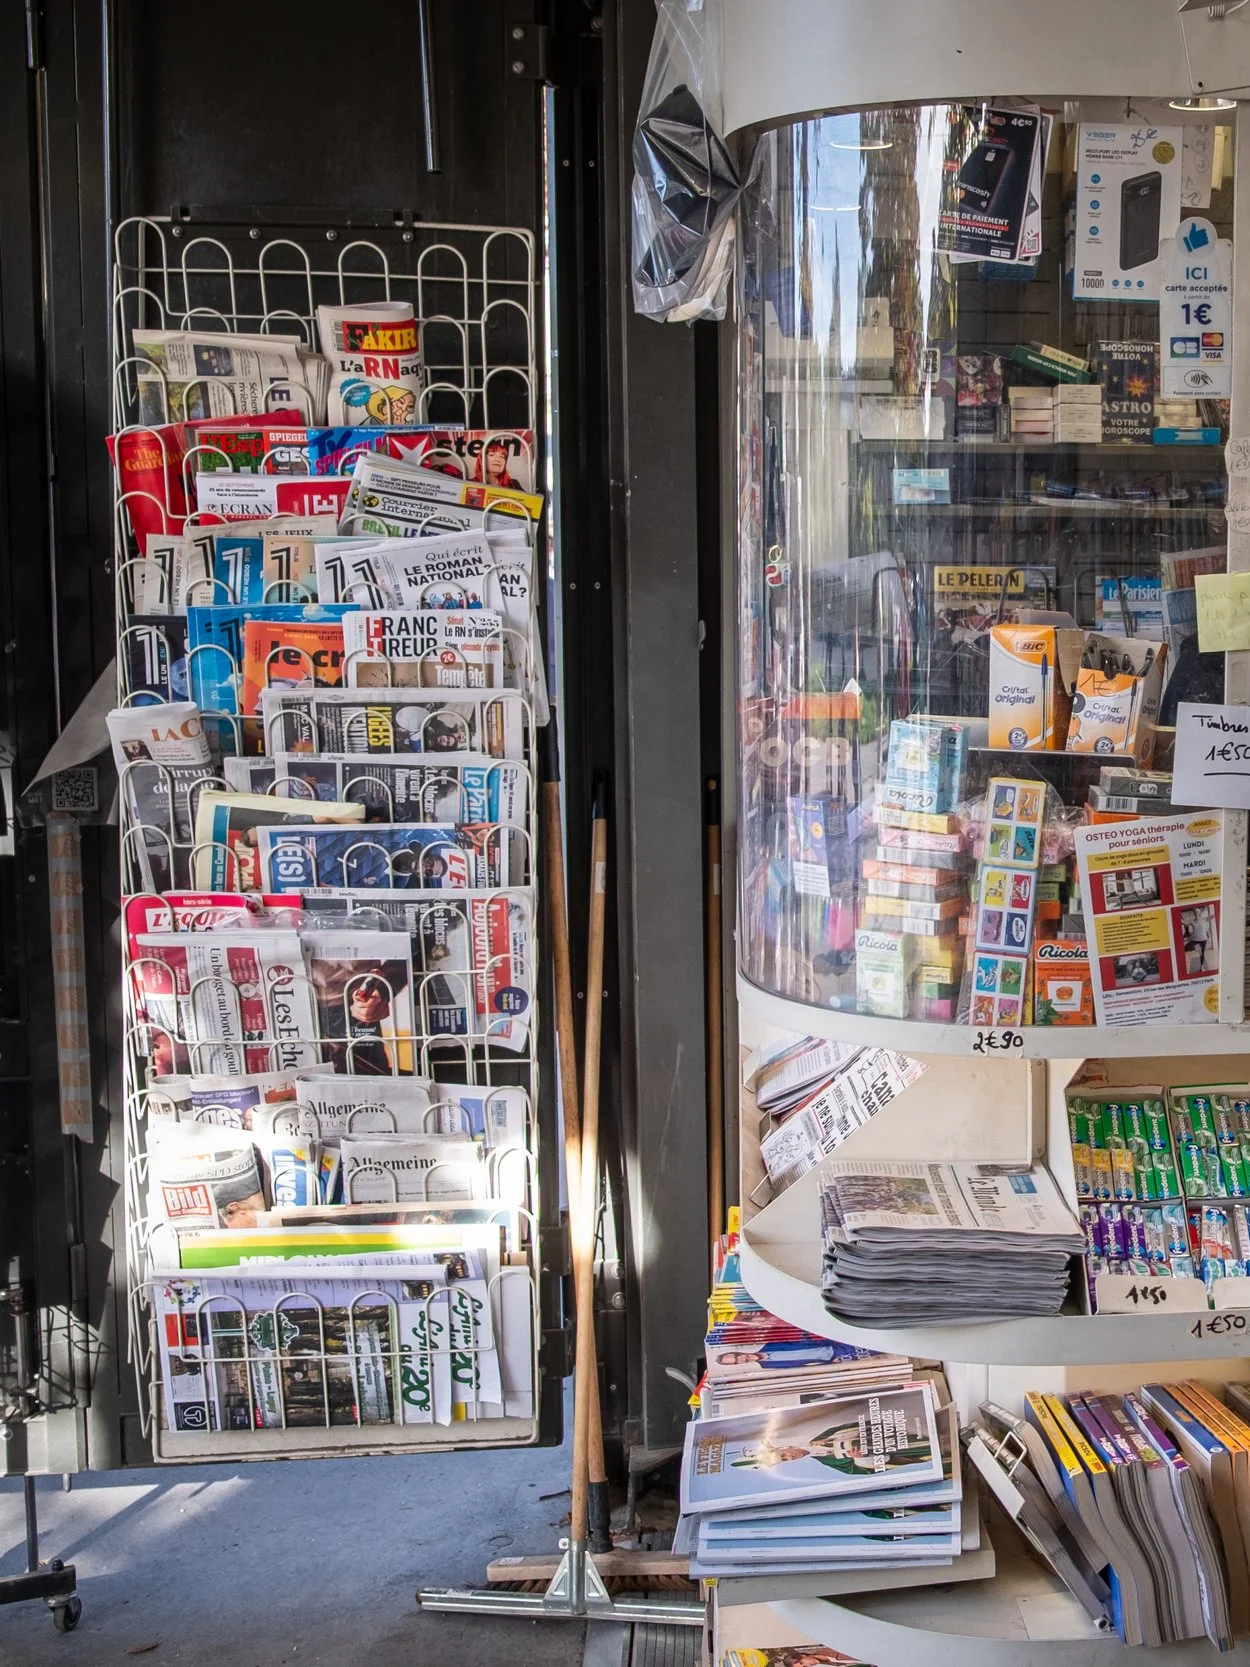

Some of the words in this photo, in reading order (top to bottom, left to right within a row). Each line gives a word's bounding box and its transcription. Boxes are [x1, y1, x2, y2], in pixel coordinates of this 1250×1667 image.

[973, 215, 1009, 226] PAIEMENT
[1185, 266, 1208, 280] ICI
[1165, 284, 1187, 292] carte
[1189, 284, 1228, 293] acceptée
[1181, 303, 1212, 325] 1€
[346, 323, 417, 351] FAKIR
[1205, 351, 1222, 359] VISA
[1101, 400, 1151, 414] ASTRO
[1110, 418, 1140, 427] VOTRE
[219, 503, 273, 515] ECRAN
[381, 496, 438, 512] Courrier
[425, 552, 451, 562] Qui
[454, 544, 483, 558] écrit
[404, 566, 422, 576] LE
[424, 556, 483, 573] ROMAN
[367, 616, 438, 636] FRANC
[445, 626, 454, 637] Le
[455, 626, 466, 637] RN
[995, 693, 1036, 705] Original
[1085, 830, 1118, 842] OSTEO
[1119, 826, 1147, 838] YOGA
[1108, 839, 1131, 850] pour
[1183, 840, 1205, 850] LUNDI
[1183, 860, 1206, 869] MARDI
[209, 947, 221, 963] Un
[1039, 944, 1089, 960] Ricola
[217, 998, 227, 1011] au
[272, 988, 295, 1024] Les
[219, 1012, 234, 1037] bord
[882, 1409, 895, 1438] VOYAGE
[894, 1409, 908, 1450] HISTORIQUE
[873, 1454, 886, 1473] LES
